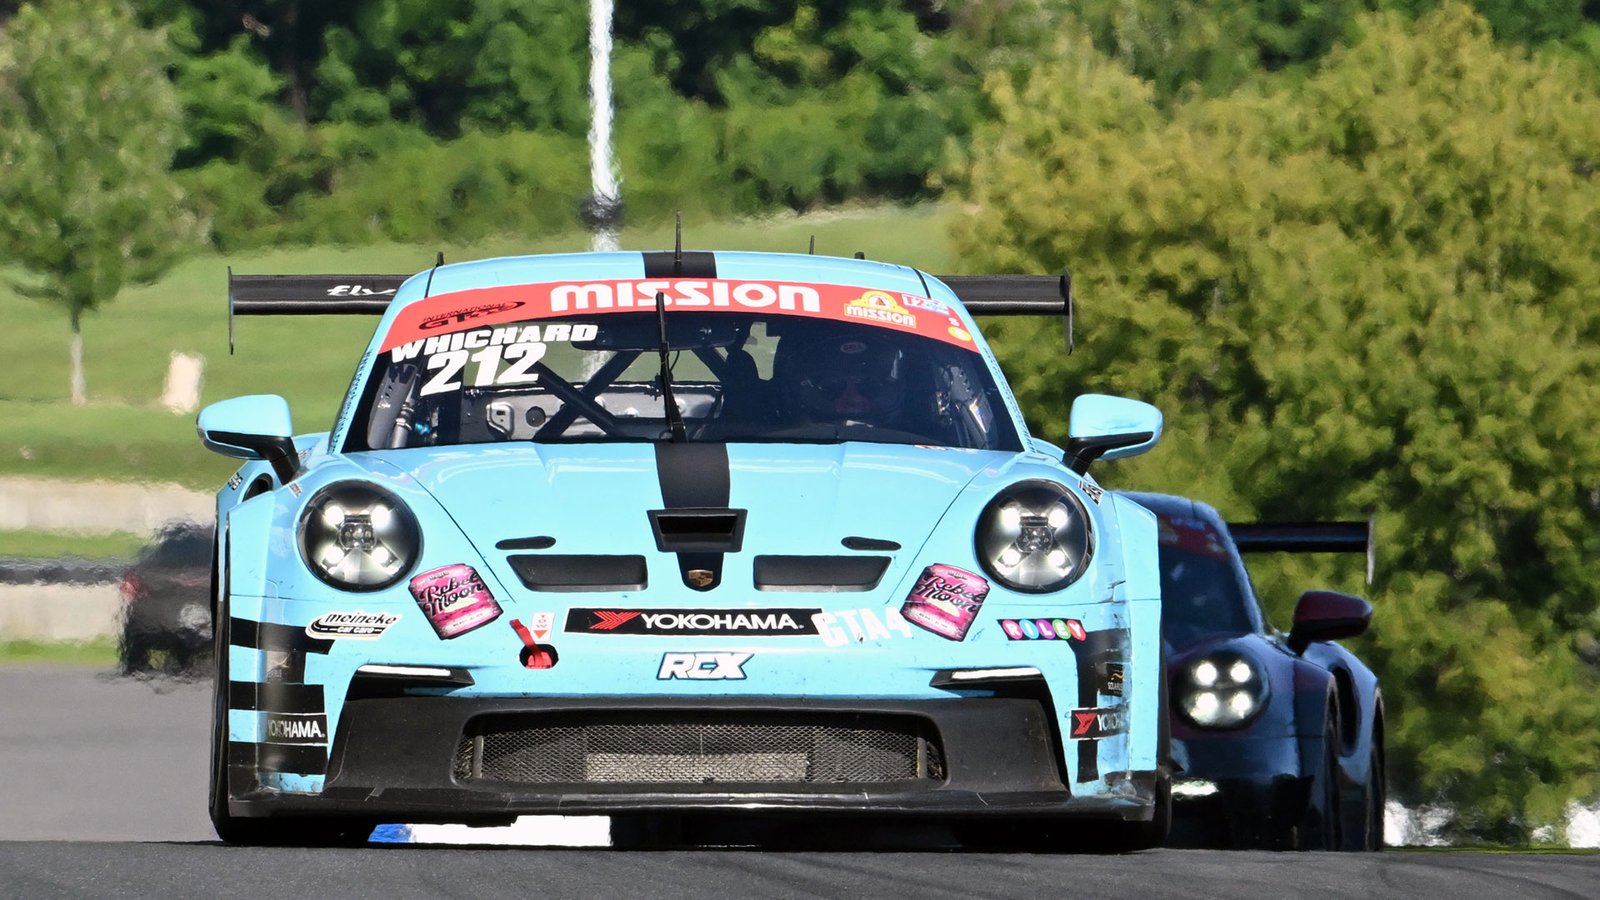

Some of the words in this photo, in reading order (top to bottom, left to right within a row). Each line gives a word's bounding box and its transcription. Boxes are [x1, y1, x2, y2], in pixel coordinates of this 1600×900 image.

[391, 323, 599, 363] WHICHARD
[420, 342, 547, 397] 212
[325, 612, 397, 624] meineke
[811, 607, 914, 648] GTA4
[1008, 624, 1083, 637] RILEY
[656, 651, 755, 681] RCX
